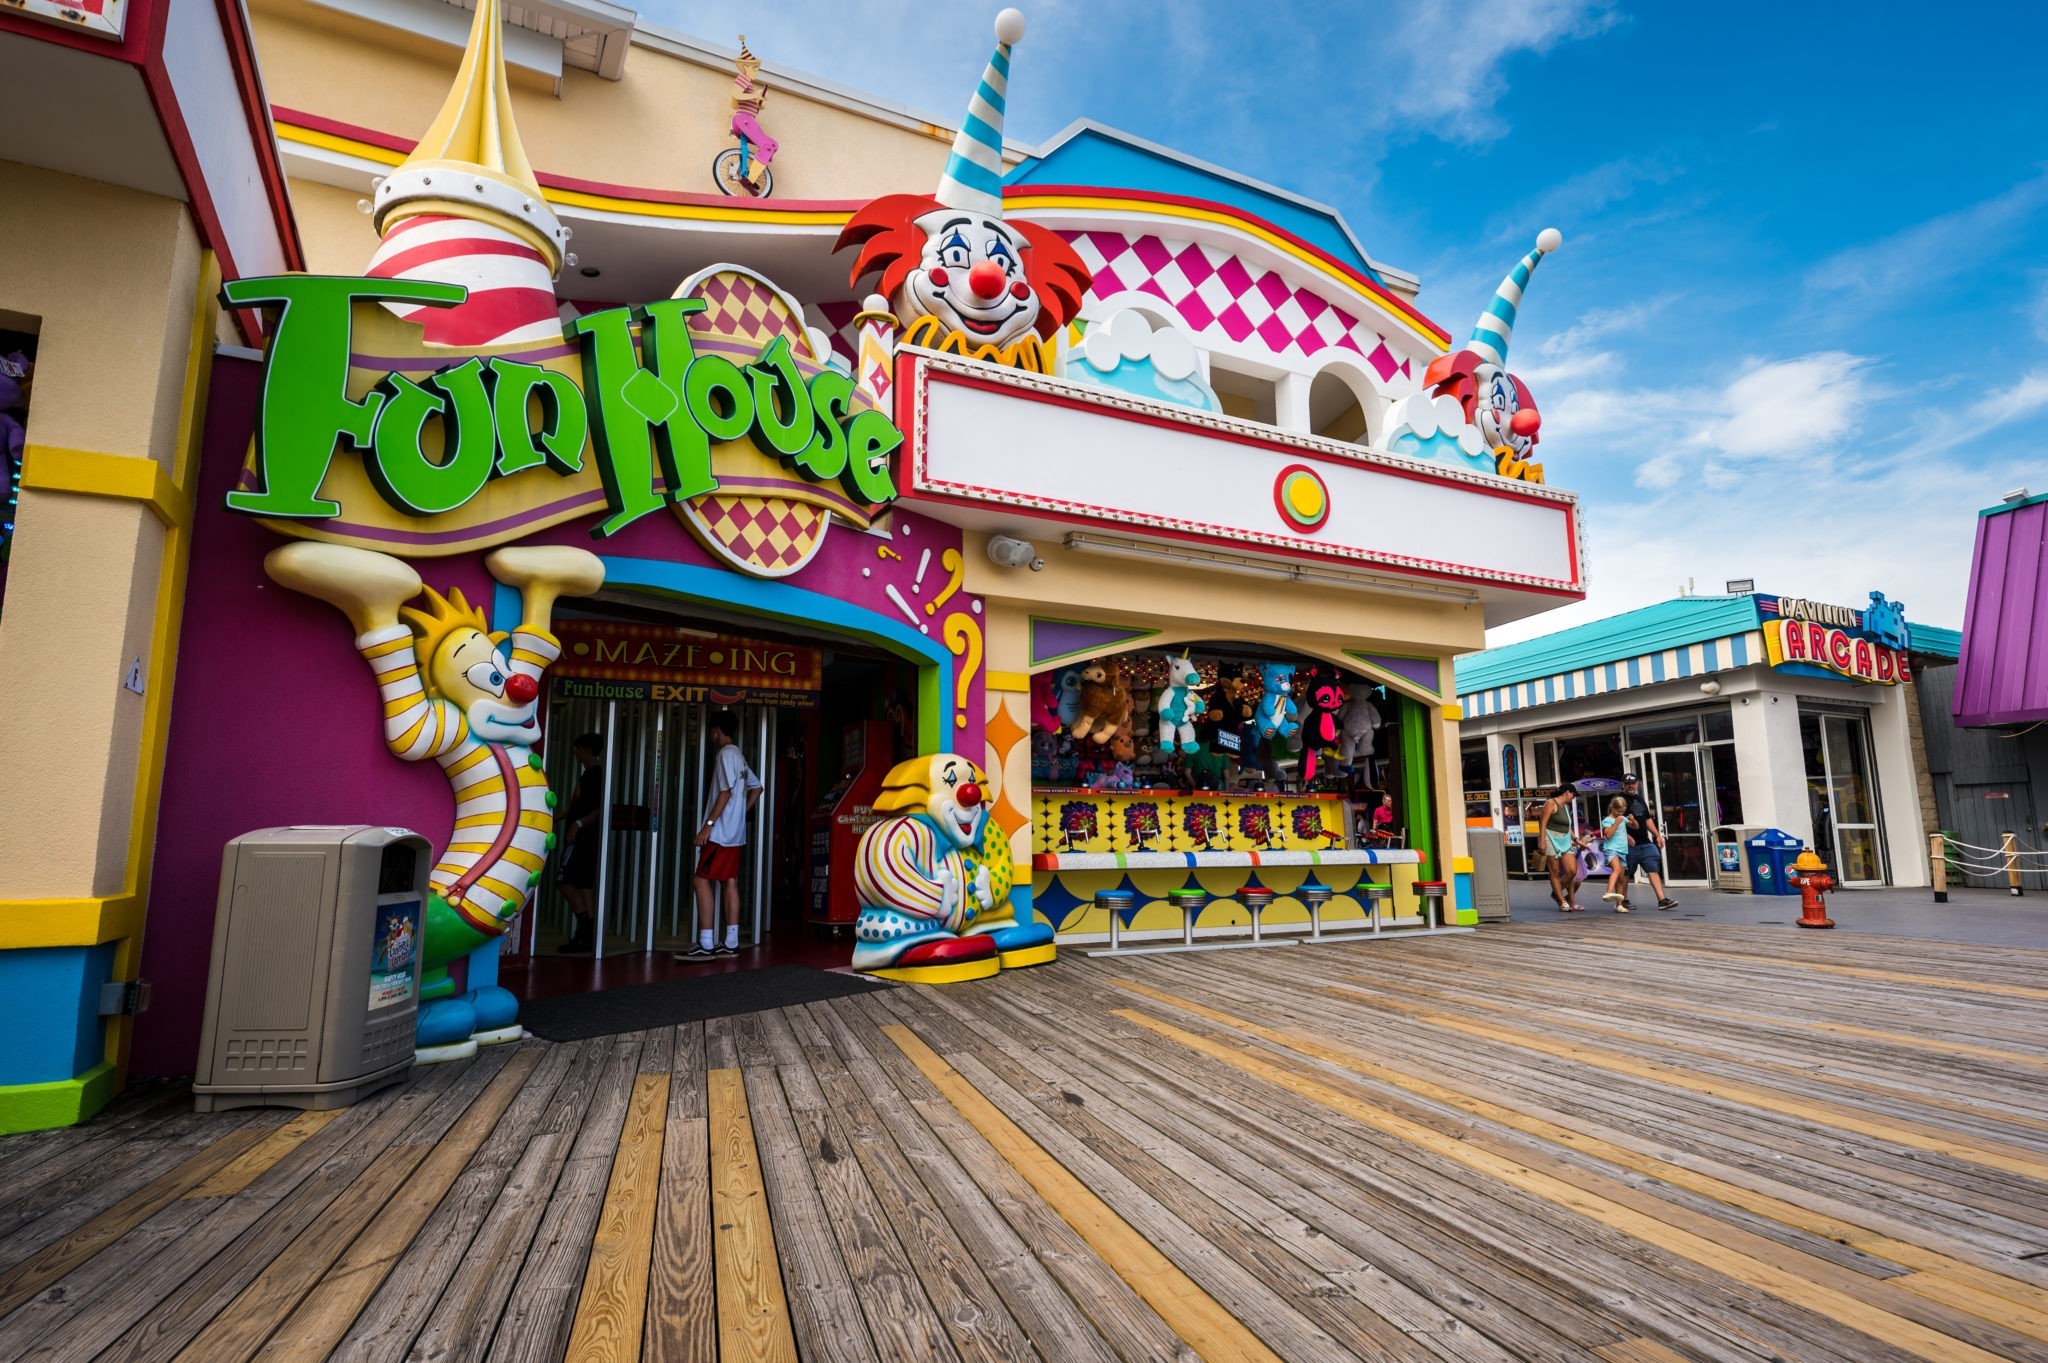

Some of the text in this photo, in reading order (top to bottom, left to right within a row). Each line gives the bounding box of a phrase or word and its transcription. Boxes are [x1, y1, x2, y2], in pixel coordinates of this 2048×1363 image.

[1778, 597, 1857, 628] PAVILION
[1781, 619, 1912, 684] ARCADE
[563, 680, 709, 702] Funhouse EXIT
[780, 699, 795, 707] candy
[1220, 738, 1239, 750] PRIZE
[838, 815, 860, 823] GAME
